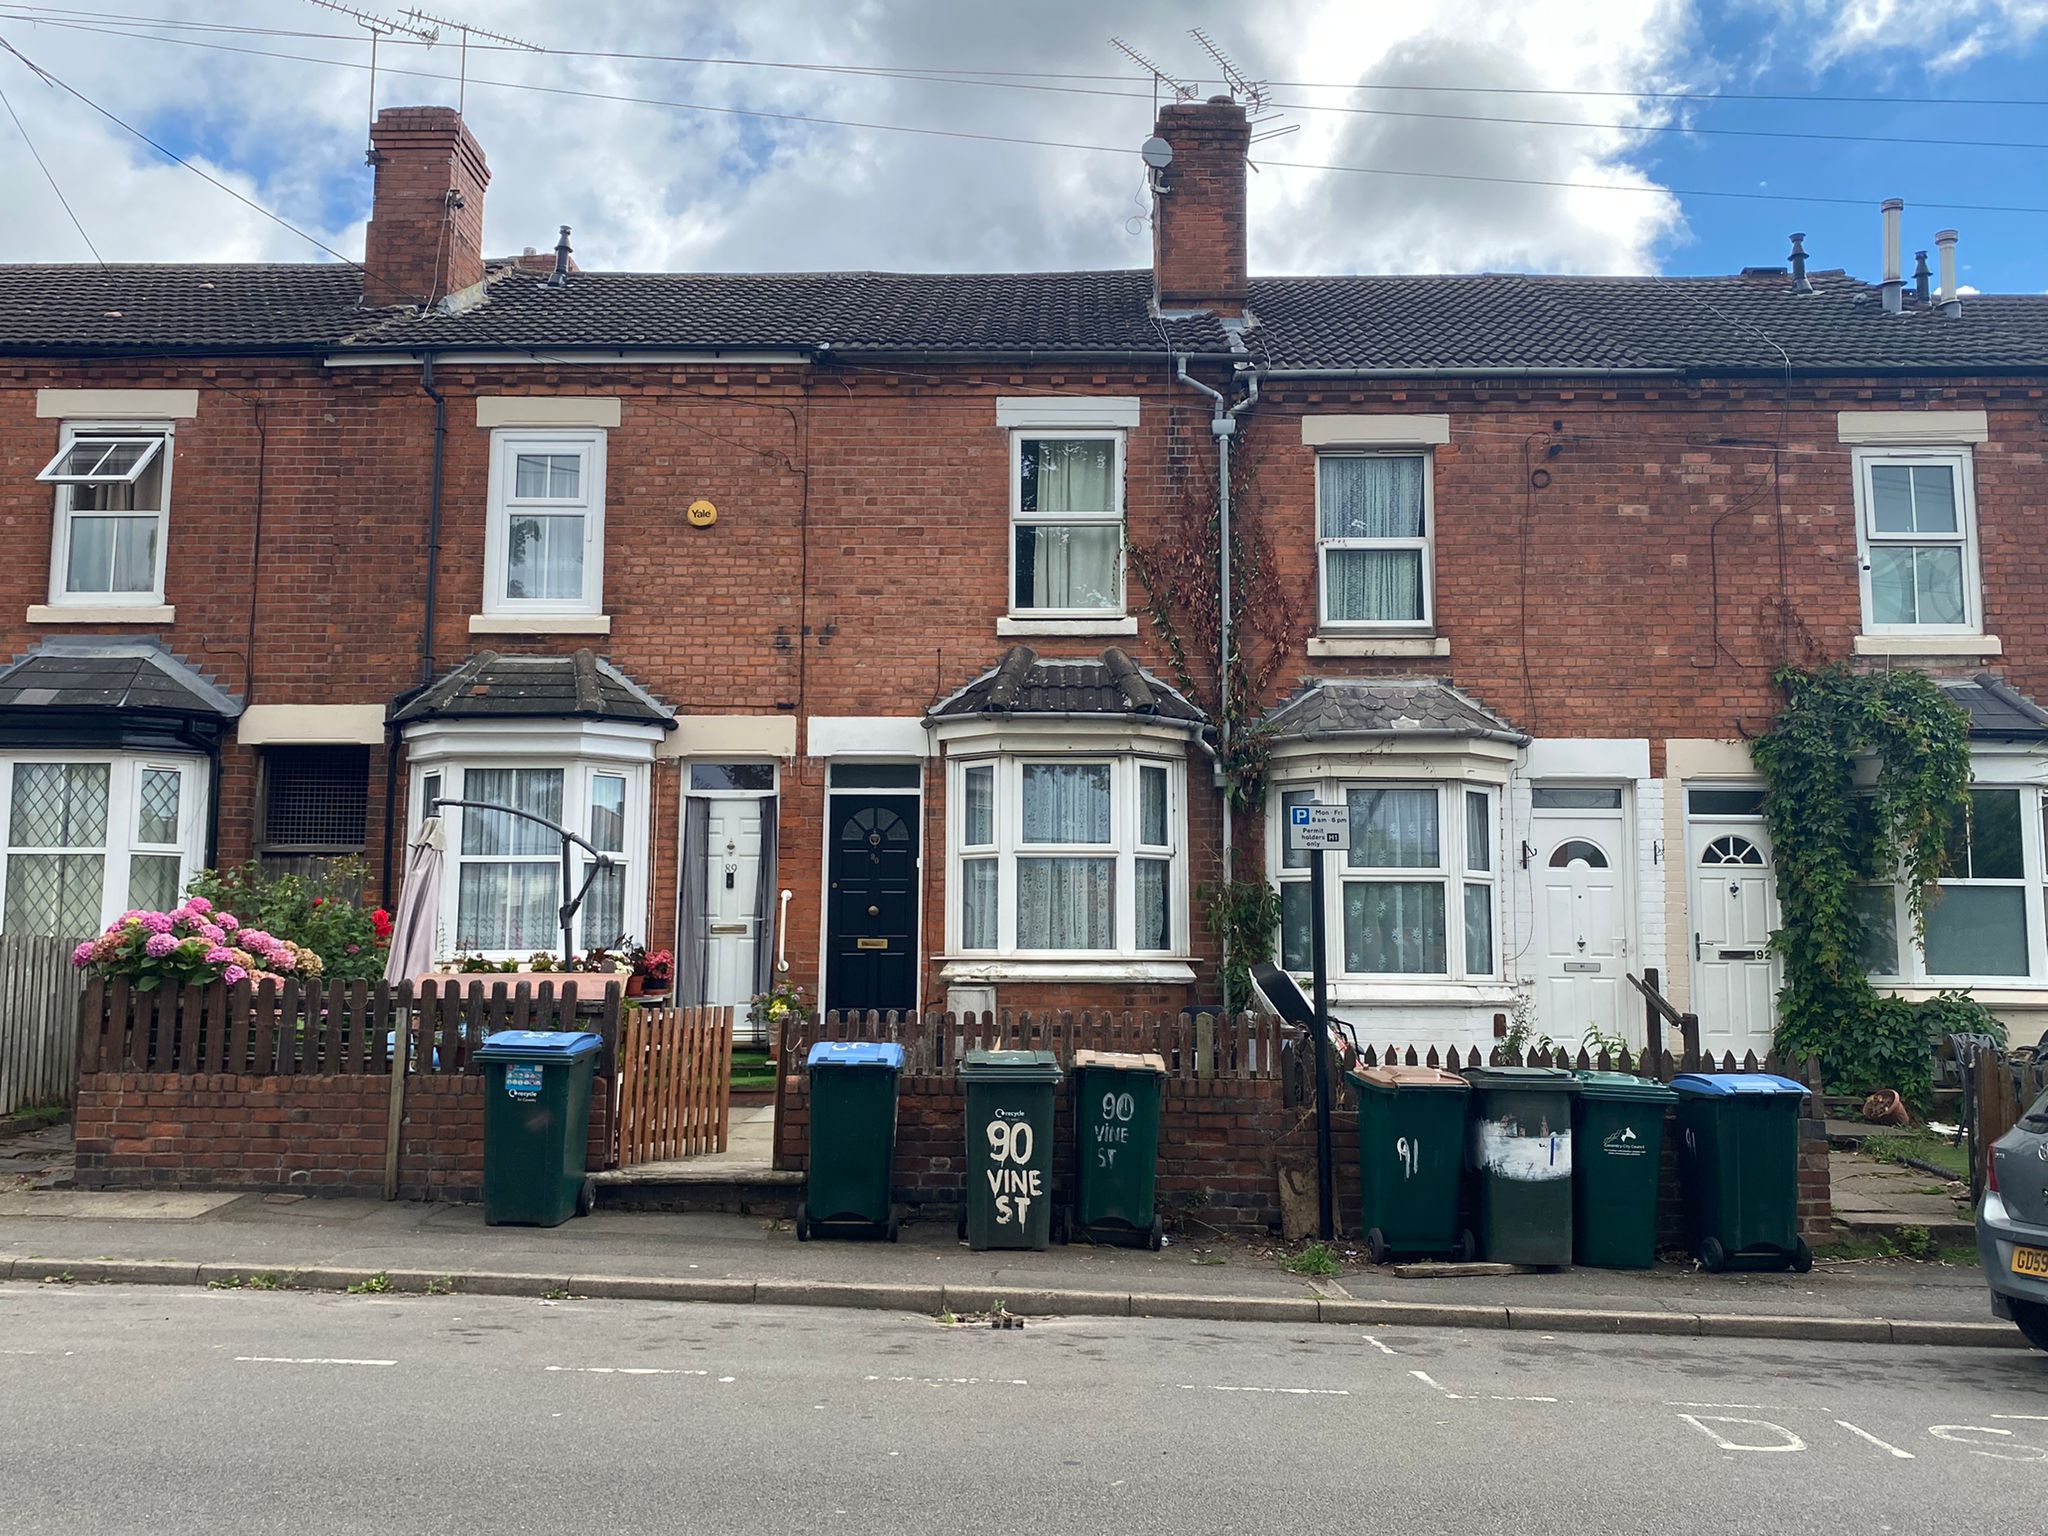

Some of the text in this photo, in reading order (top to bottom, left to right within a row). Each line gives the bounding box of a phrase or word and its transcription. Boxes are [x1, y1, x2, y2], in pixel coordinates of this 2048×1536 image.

[691, 509, 711, 518] Yale
[1297, 810, 1307, 823] P
[724, 863, 737, 873] 89
[1756, 950, 1772, 960] 92
[1102, 1092, 1134, 1121] 90
[986, 1120, 1033, 1165] 90
[1098, 1147, 1117, 1169] ST
[1397, 1137, 1418, 1178] 91
[986, 1169, 1042, 1197] VINE
[995, 1195, 1030, 1228] ST
[2017, 1250, 2048, 1272] GD59
